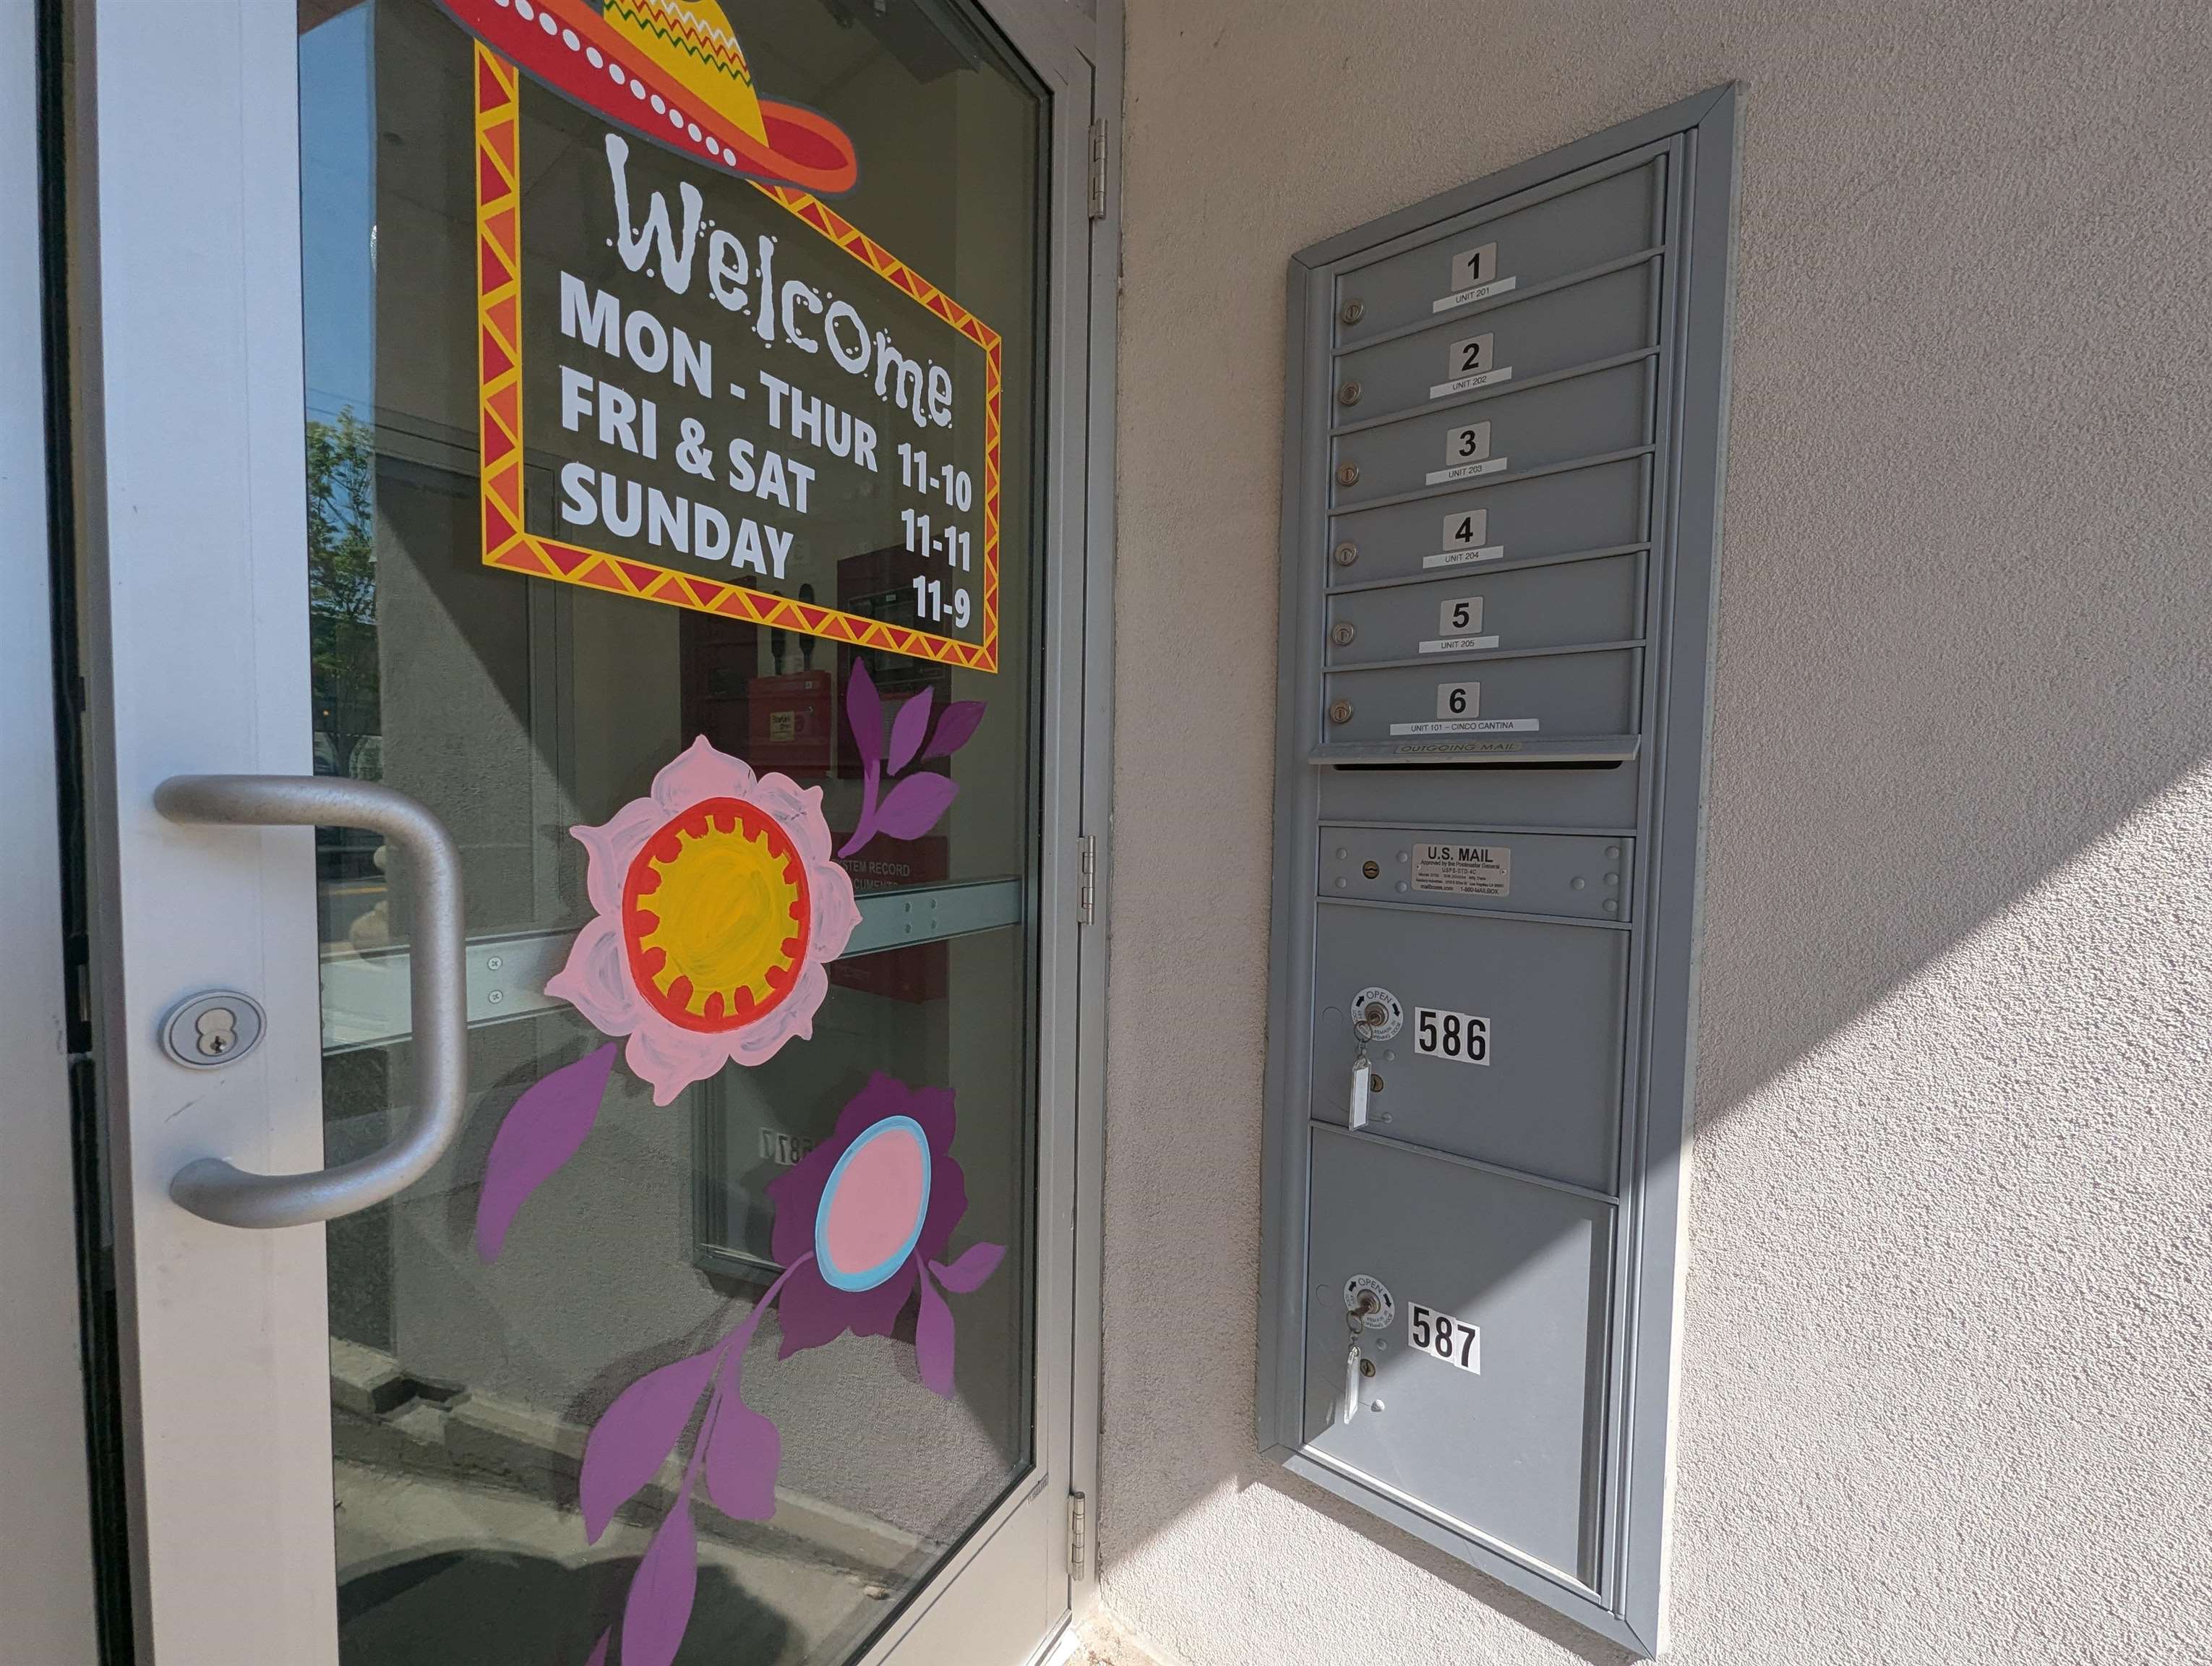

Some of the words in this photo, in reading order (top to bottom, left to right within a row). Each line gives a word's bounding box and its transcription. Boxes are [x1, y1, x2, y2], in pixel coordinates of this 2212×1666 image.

[1467, 252, 1480, 280] 1
[605, 133, 953, 428] Welcome
[1456, 291, 1475, 304] UNIT
[1475, 287, 1490, 299] 201
[1462, 343, 1480, 372] 2
[560, 270, 712, 398] MON
[730, 383, 746, 400] -
[759, 369, 878, 472] THUR
[897, 443, 972, 512] 11-10
[1452, 377, 1471, 390] UNIT
[1472, 375, 1487, 388] 202
[1459, 430, 1477, 457] 3
[560, 366, 657, 460] FRI
[675, 417, 715, 481] &
[729, 437, 815, 513] SAT
[901, 508, 971, 573] 11-11
[1448, 466, 1467, 479] UNIT
[1467, 464, 1483, 476] 203
[1454, 516, 1473, 543] 4
[560, 462, 794, 580] SUNDAY
[912, 575, 971, 628] 11-9
[1445, 552, 1464, 563] UNIT
[1465, 550, 1480, 562] 204
[1452, 602, 1470, 628] 5
[1441, 640, 1459, 649] UNIT
[1460, 638, 1475, 649] 205
[1448, 688, 1467, 714] 6
[1400, 743, 1475, 753] OUTGOING
[1479, 743, 1516, 751] MAIL
[839, 860, 866, 873] STEM
[869, 862, 910, 876] RECORD
[1420, 859, 1441, 868] Approved
[1428, 847, 1453, 860] U.S.
[1459, 848, 1493, 863] MAIL
[1366, 990, 1392, 1004] OPEN
[1419, 1010, 1486, 1061] 586
[1358, 1278, 1383, 1294] OPEN
[1412, 1306, 1476, 1367] 587
